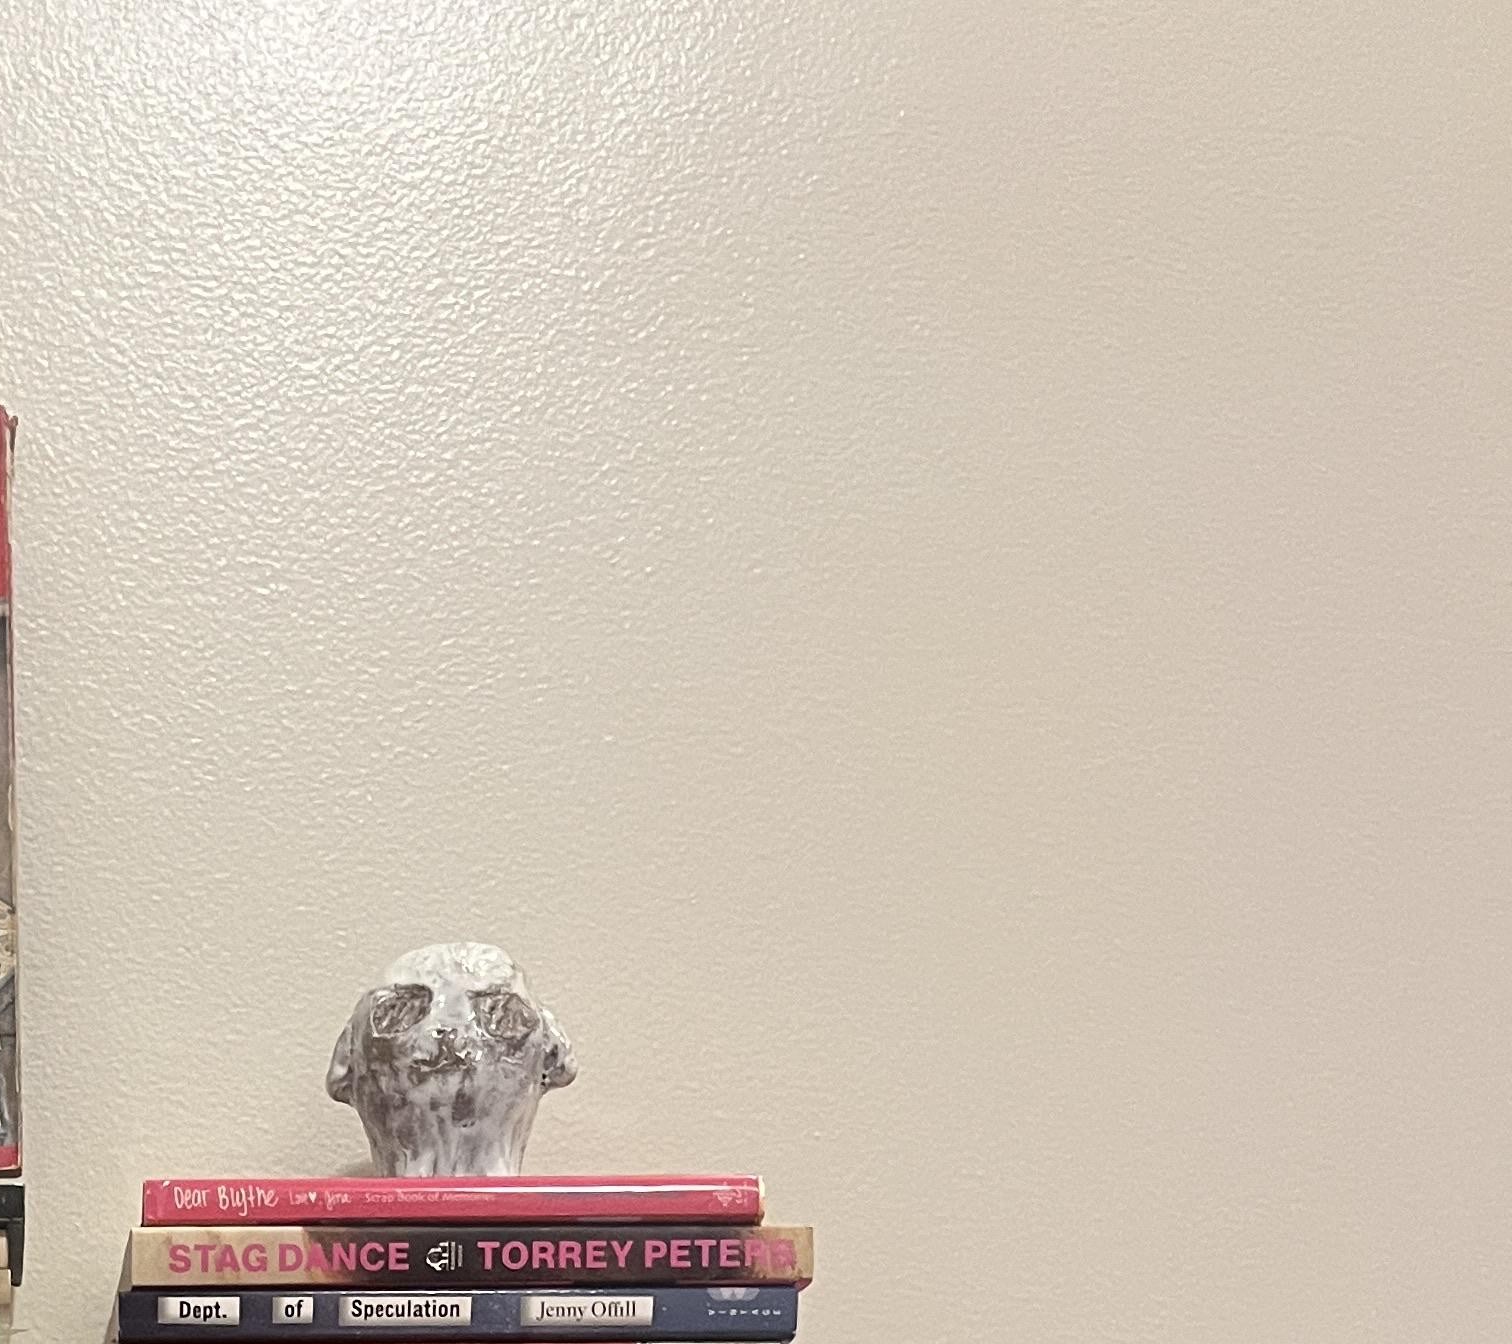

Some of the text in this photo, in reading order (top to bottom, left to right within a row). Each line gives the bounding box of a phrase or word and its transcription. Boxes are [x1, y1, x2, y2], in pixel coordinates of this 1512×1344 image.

[170, 1242, 410, 1273] STAG DANCE
[477, 1241, 636, 1269] TORREY
[179, 1297, 636, 1322] Dept. of Speculation Jenny Offill
